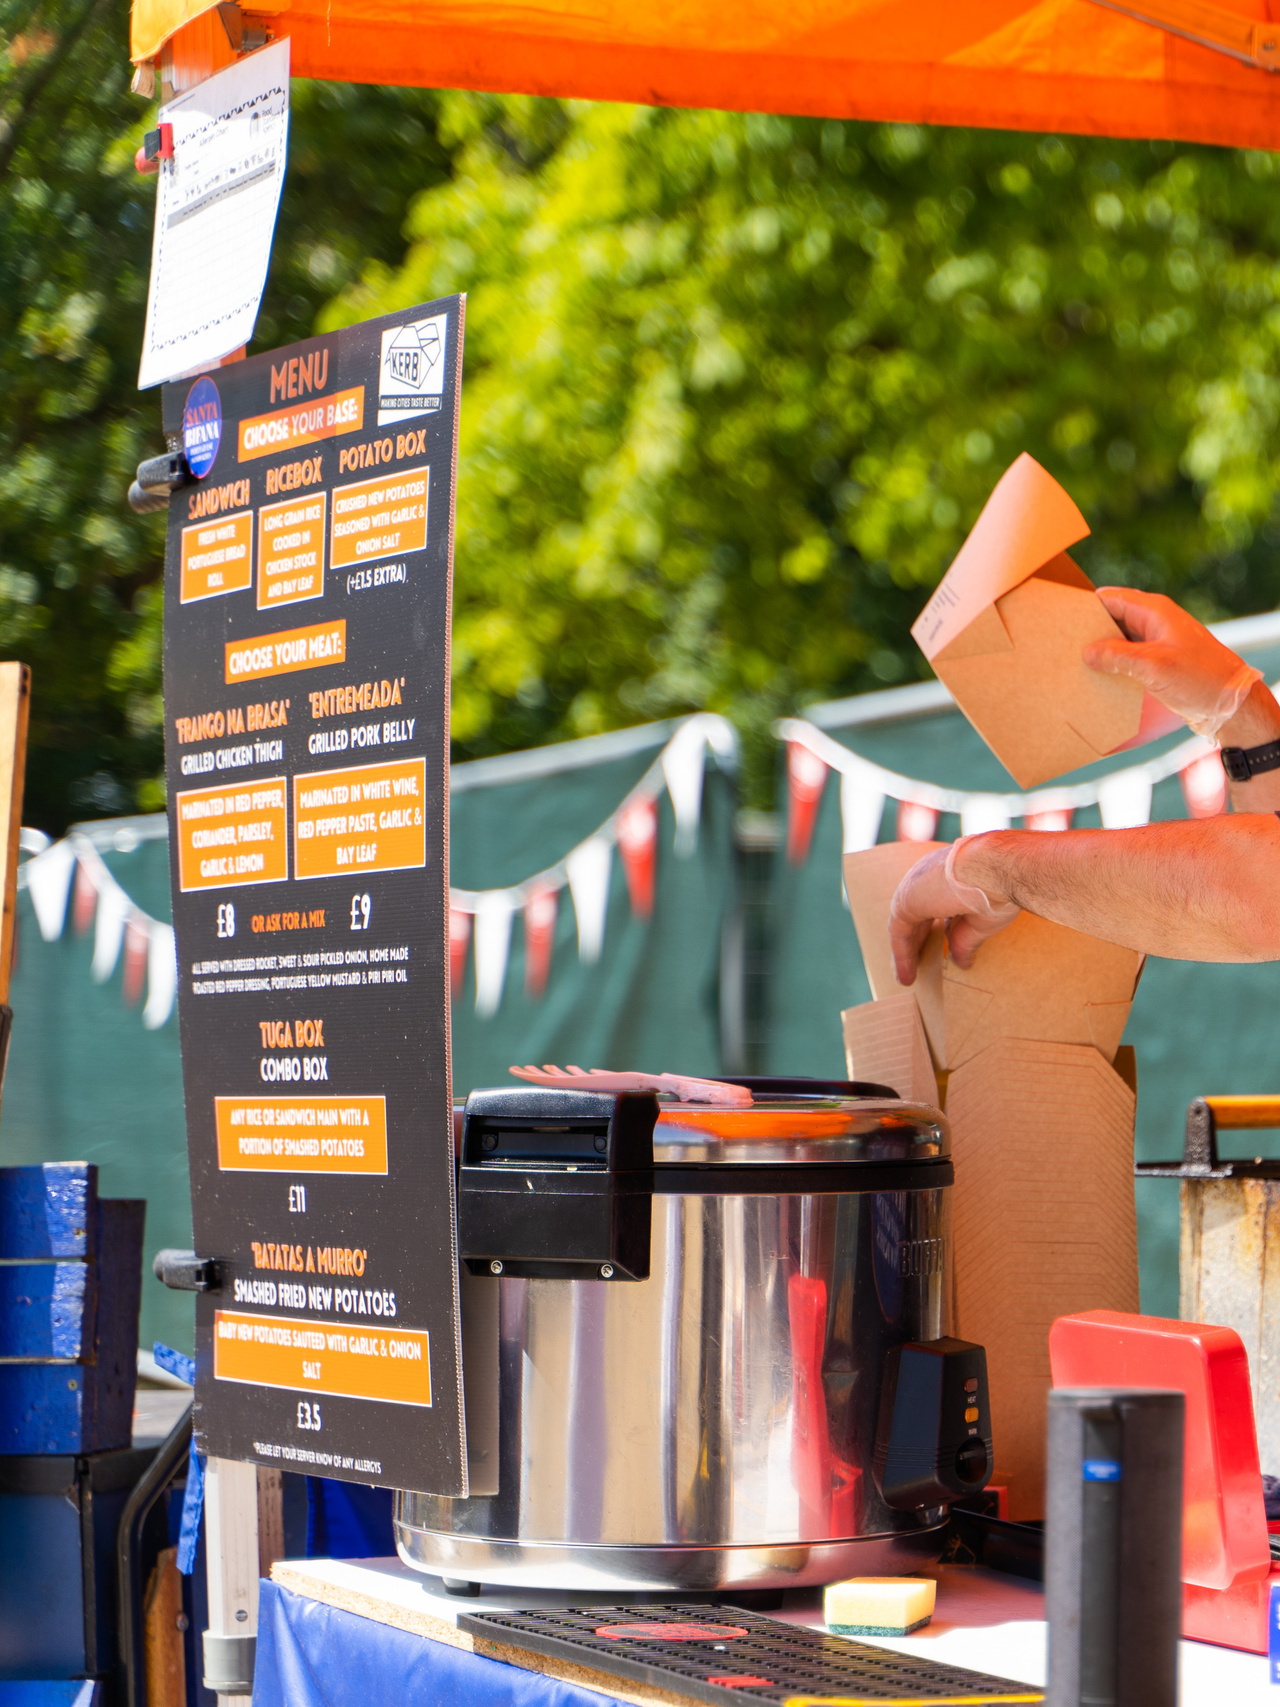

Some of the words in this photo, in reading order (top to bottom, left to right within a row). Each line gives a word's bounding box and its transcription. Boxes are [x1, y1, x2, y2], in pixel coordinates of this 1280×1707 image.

[270, 349, 328, 404] MENU
[392, 351, 420, 382] KERB
[186, 402, 218, 428] SANTA
[244, 414, 289, 449] CHOOSE
[291, 407, 324, 436] YOUR
[327, 397, 358, 426] BASE:
[186, 420, 220, 448] BIFANA
[339, 438, 392, 474] POTATO
[396, 428, 426, 460] BOX
[266, 456, 322, 496] RICEBOX
[188, 478, 250, 520] SANDWICH
[336, 494, 366, 514] CRUSHED
[368, 490, 384, 506] NEW
[386, 481, 425, 502] POTATOES
[264, 512, 282, 531] LONG
[284, 508, 304, 527] GRAIN
[305, 504, 321, 522] RICE
[334, 515, 370, 537] SEASONED
[371, 511, 390, 528] WITH
[390, 506, 417, 524] GARLIC
[418, 504, 424, 518] &
[272, 532, 302, 552] COOKED
[302, 530, 310, 544] IN
[356, 537, 382, 555] ONION
[383, 532, 400, 550] SALT
[188, 548, 225, 570] PORTUGUESE
[226, 544, 246, 562] BREAD
[266, 558, 293, 576] CHICKEN
[294, 552, 317, 570] STOCK
[268, 582, 282, 598] AND
[283, 578, 298, 595] BAY
[298, 574, 314, 592] LEAF
[346, 571, 372, 595] (+£1.5
[374, 563, 406, 588] EXTRA)
[228, 646, 273, 675] CHOOSE
[274, 639, 306, 665] YOUR
[309, 631, 342, 658] MEAT:
[308, 676, 406, 719] 'ENTREMEADA'
[227, 708, 244, 735] NA
[246, 698, 290, 730] BRASA'
[308, 728, 348, 755] GRILLED
[350, 724, 380, 749] PORK
[382, 718, 416, 744] BELLY
[181, 750, 215, 776] GRILLED
[216, 745, 254, 770] CHICKEN
[254, 740, 283, 762] THIGH
[182, 798, 224, 821] MARINATED
[224, 796, 234, 814] IN
[234, 793, 250, 812] RED
[252, 788, 284, 810] PEPPER,
[300, 786, 348, 809] MARINATED
[350, 784, 361, 802] IN
[362, 779, 390, 800] WHITE
[392, 776, 419, 798] WINE,
[191, 826, 237, 850] CORIANDER,
[238, 820, 274, 842] PARSLEY,
[298, 820, 314, 839] RED
[316, 816, 347, 838] PEPPER
[348, 812, 378, 834] PASTE,
[378, 810, 412, 830] GARLIC
[414, 807, 422, 826] &
[200, 858, 227, 878] GARLIC
[228, 856, 234, 874] &
[235, 853, 264, 873] LEMON
[336, 846, 354, 865] BAY
[356, 844, 377, 862] LEAF
[216, 903, 236, 938] £8
[252, 916, 265, 933] OR
[266, 914, 282, 932] ASK
[282, 912, 300, 930] FOR
[301, 912, 308, 928] A
[309, 909, 326, 928] MIX
[350, 894, 371, 930] £9
[302, 953, 320, 968] SOUR
[320, 951, 344, 966] PICKLED
[344, 950, 369, 965] ONION,
[370, 948, 388, 962] HOME
[390, 946, 408, 960] MADE
[271, 974, 308, 990] PORTUGUESE
[308, 974, 332, 988] YELLOW
[332, 972, 360, 986] MUSTARD
[362, 971, 368, 984] &
[368, 970, 380, 984] PIRI
[382, 970, 394, 984] PIRI
[396, 968, 408, 982] OIL
[259, 1020, 294, 1049] TUGA
[295, 1019, 324, 1048] BOX
[260, 1057, 301, 1082] COMBO
[303, 1056, 328, 1081] BOX
[230, 1108, 246, 1125] ANY
[246, 1108, 262, 1126] RICE
[263, 1108, 275, 1126] OR
[276, 1108, 316, 1126] SANDWICH
[316, 1108, 338, 1126] MAIN
[339, 1108, 361, 1126] WITH
[362, 1108, 370, 1126] A
[238, 1137, 272, 1155] PORTION
[272, 1138, 284, 1156] OF
[284, 1138, 320, 1156] SMASHED
[320, 1138, 365, 1157] POTATOES
[288, 1185, 306, 1213] £11
[305, 1246, 316, 1273] A
[316, 1245, 368, 1277] MURRO'
[234, 1278, 277, 1306] SMASHED
[278, 1282, 307, 1309] FRIED
[308, 1286, 332, 1312] NEW
[334, 1288, 396, 1317] POTATOES
[218, 1320, 236, 1339] BABY
[237, 1322, 254, 1341] NEW
[254, 1326, 292, 1346] POTATOES
[292, 1330, 326, 1351] SAUTEED
[326, 1333, 348, 1352] WITH
[348, 1336, 378, 1357] GARLIC
[380, 1339, 388, 1357] &
[389, 1340, 422, 1360] ONION
[302, 1360, 322, 1380] SALT
[296, 1402, 321, 1432] £3.5
[272, 1444, 282, 1458] LET
[282, 1446, 297, 1460] YOUR
[296, 1448, 316, 1464] SERVER
[316, 1452, 333, 1466] KNOW
[333, 1454, 342, 1468] OF
[342, 1456, 354, 1470] ANY
